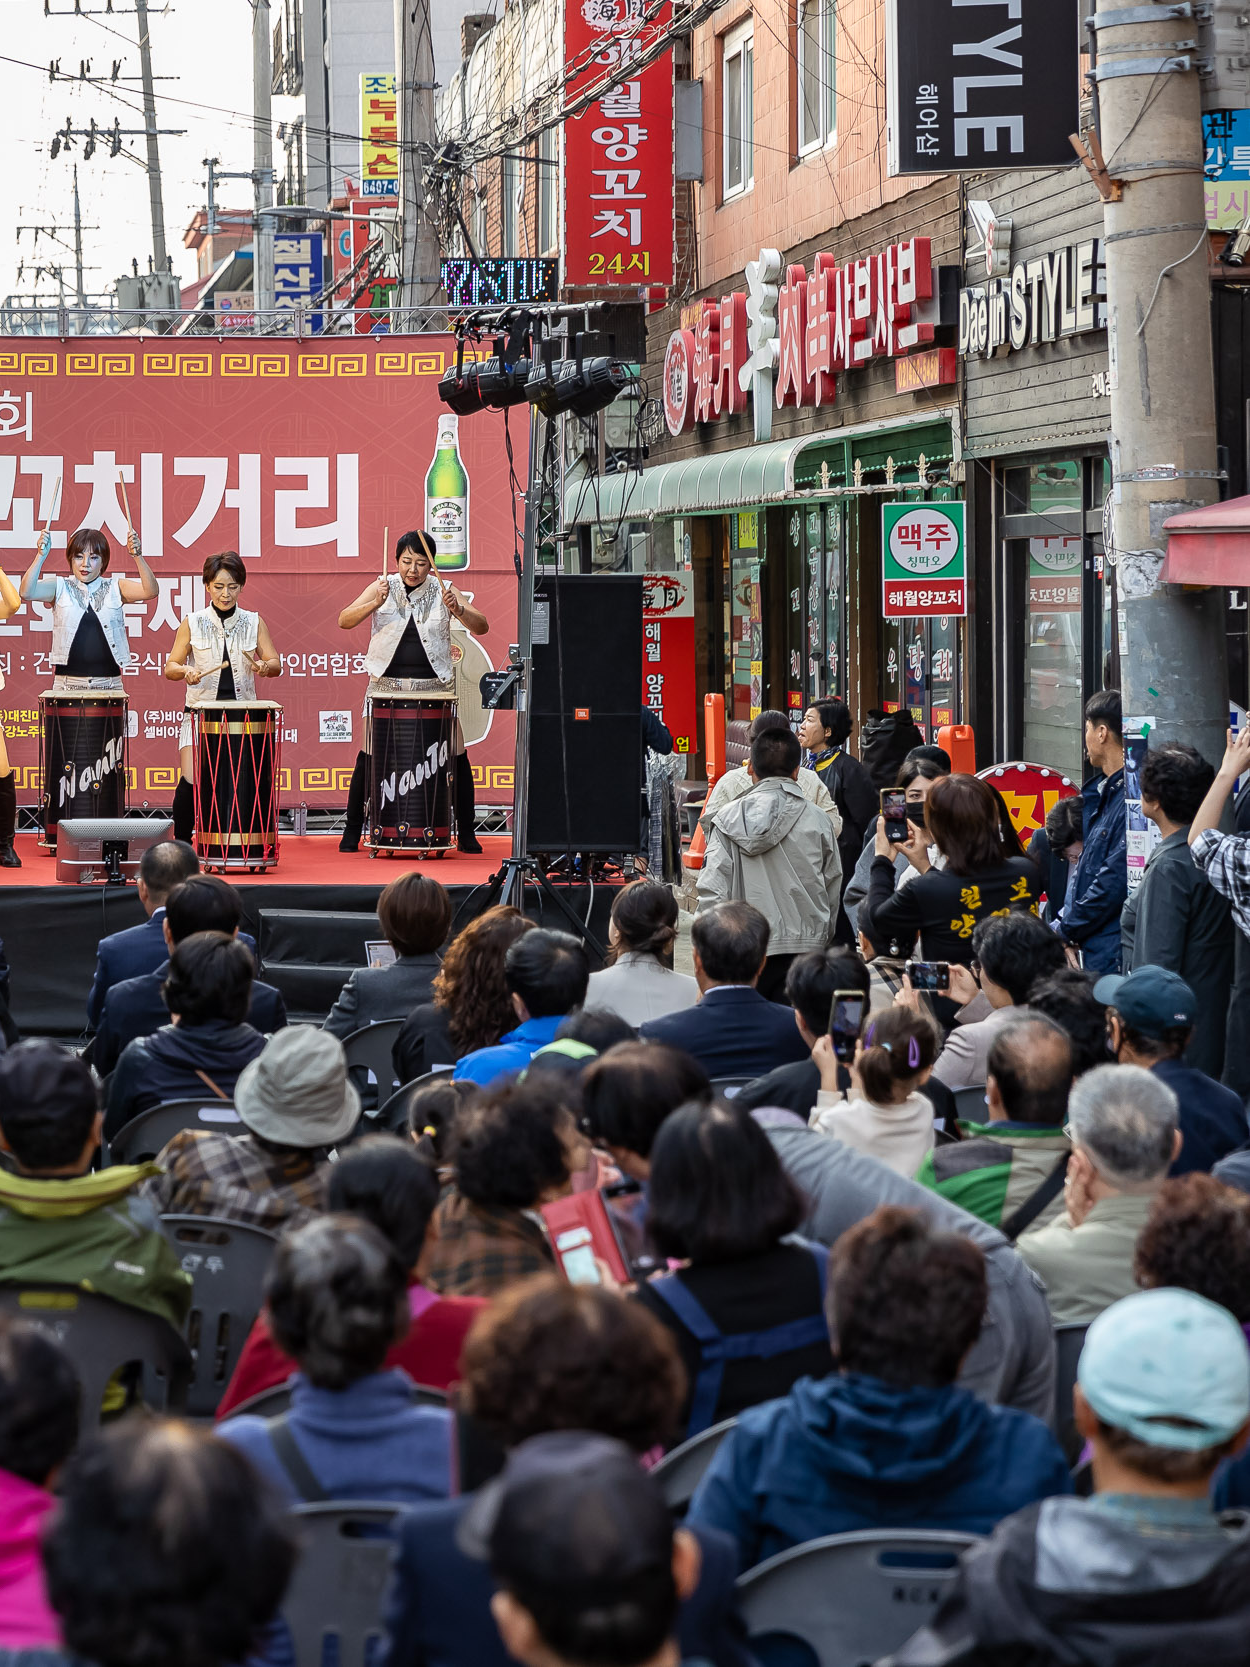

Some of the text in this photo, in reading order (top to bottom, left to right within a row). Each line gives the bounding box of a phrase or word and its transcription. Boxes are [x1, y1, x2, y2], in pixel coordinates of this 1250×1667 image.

[588, 252, 650, 276] 24시
[959, 278, 1009, 359] Daejin
[1011, 238, 1099, 350] STYLE
[897, 523, 951, 551] 맥주
[907, 556, 942, 568] 칭따오
[888, 590, 962, 607] 해월양꼬치
